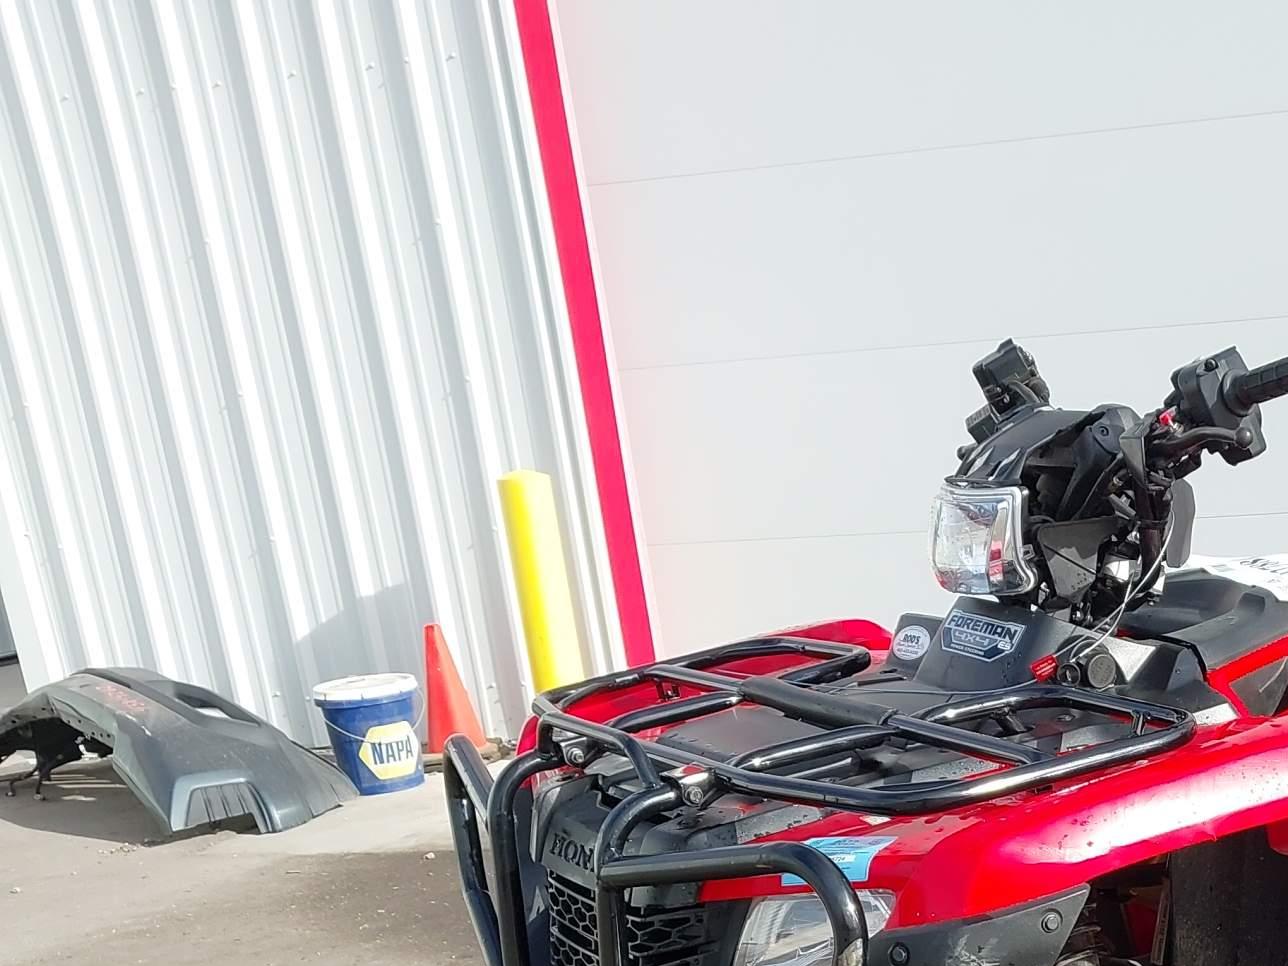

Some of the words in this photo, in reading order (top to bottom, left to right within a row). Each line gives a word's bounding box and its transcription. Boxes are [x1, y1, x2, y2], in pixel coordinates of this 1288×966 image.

[947, 614, 1018, 642] FOREMAN
[371, 735, 413, 765] NAPA
[551, 832, 596, 873] HON
